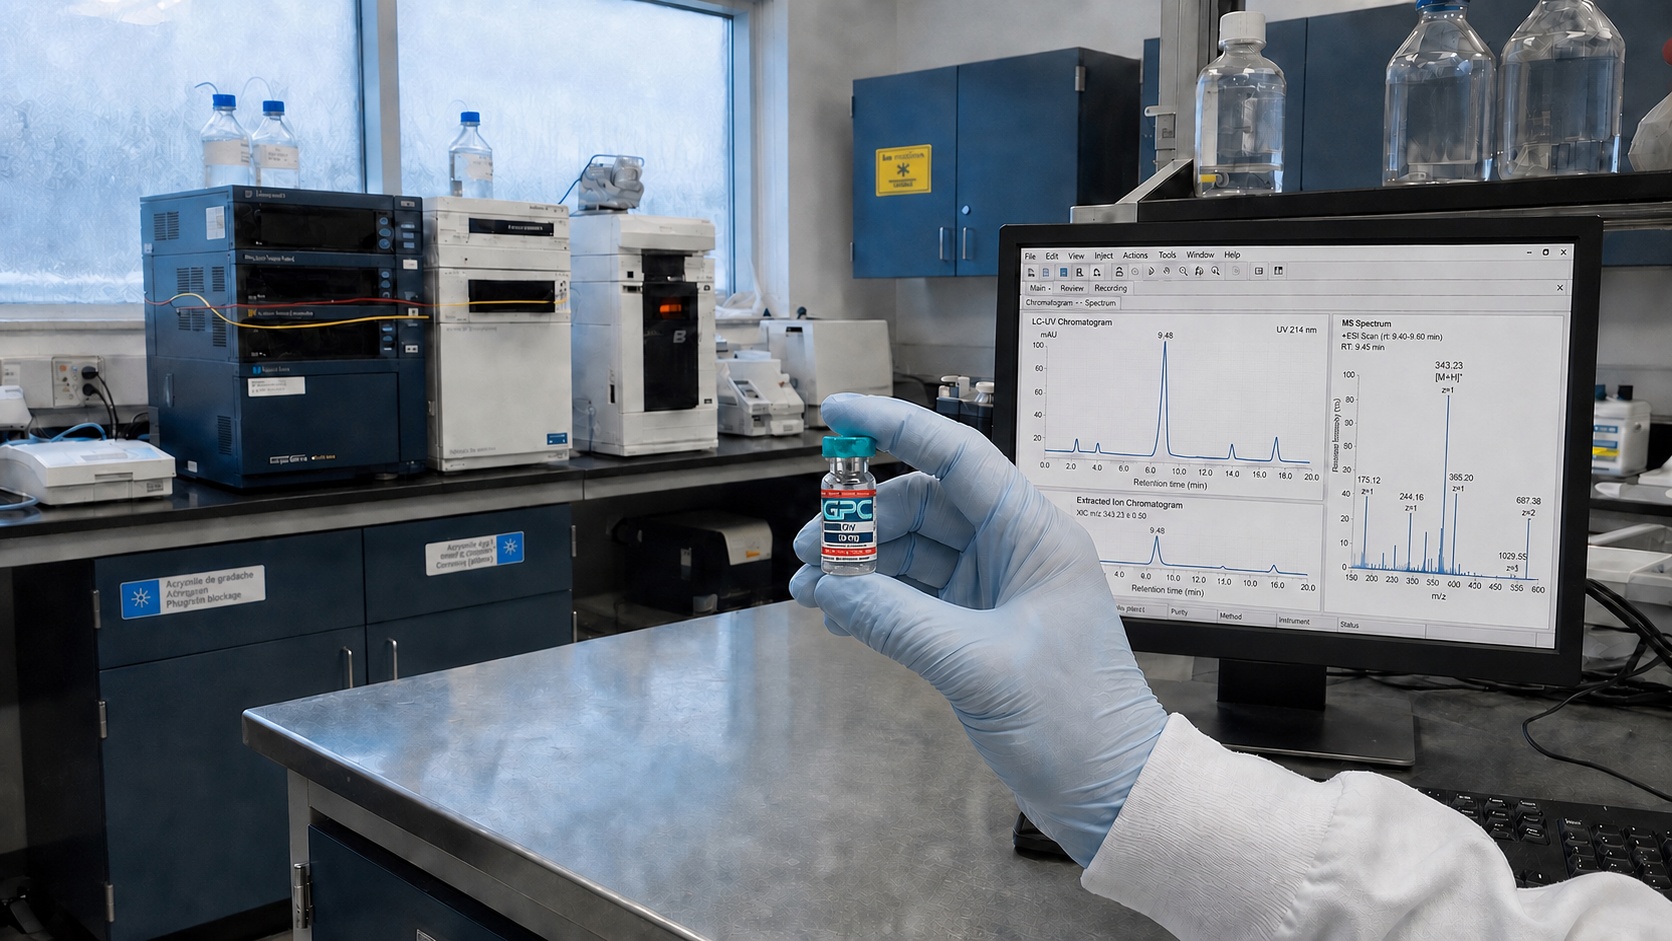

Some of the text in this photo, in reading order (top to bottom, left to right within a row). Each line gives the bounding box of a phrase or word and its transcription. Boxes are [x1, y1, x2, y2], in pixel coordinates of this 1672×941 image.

[1094, 252, 1113, 261] Inject
[1159, 251, 1177, 259] Tools
[1187, 251, 1215, 259] Window
[1224, 251, 1241, 259] Help
[1032, 318, 1113, 327] LC-UV Chromatogram
[1342, 319, 1392, 329] MS Spectrum
[1276, 326, 1288, 334] UV
[1290, 326, 1303, 334] 214
[1427, 333, 1443, 342] min)
[1435, 361, 1464, 370] 343.23
[1304, 473, 1320, 481] 20.0
[1357, 476, 1381, 484] 175.12
[1134, 479, 1168, 488] Retention
[1187, 482, 1208, 490] (min)
[1076, 497, 1184, 510] Extracted Ion Chromatogram
[823, 499, 873, 520] GPC
[1340, 539, 1349, 547] 10
[1341, 563, 1347, 571] 0
[1131, 584, 1205, 597] Retention time (min)
[207, 592, 242, 603] blockage
